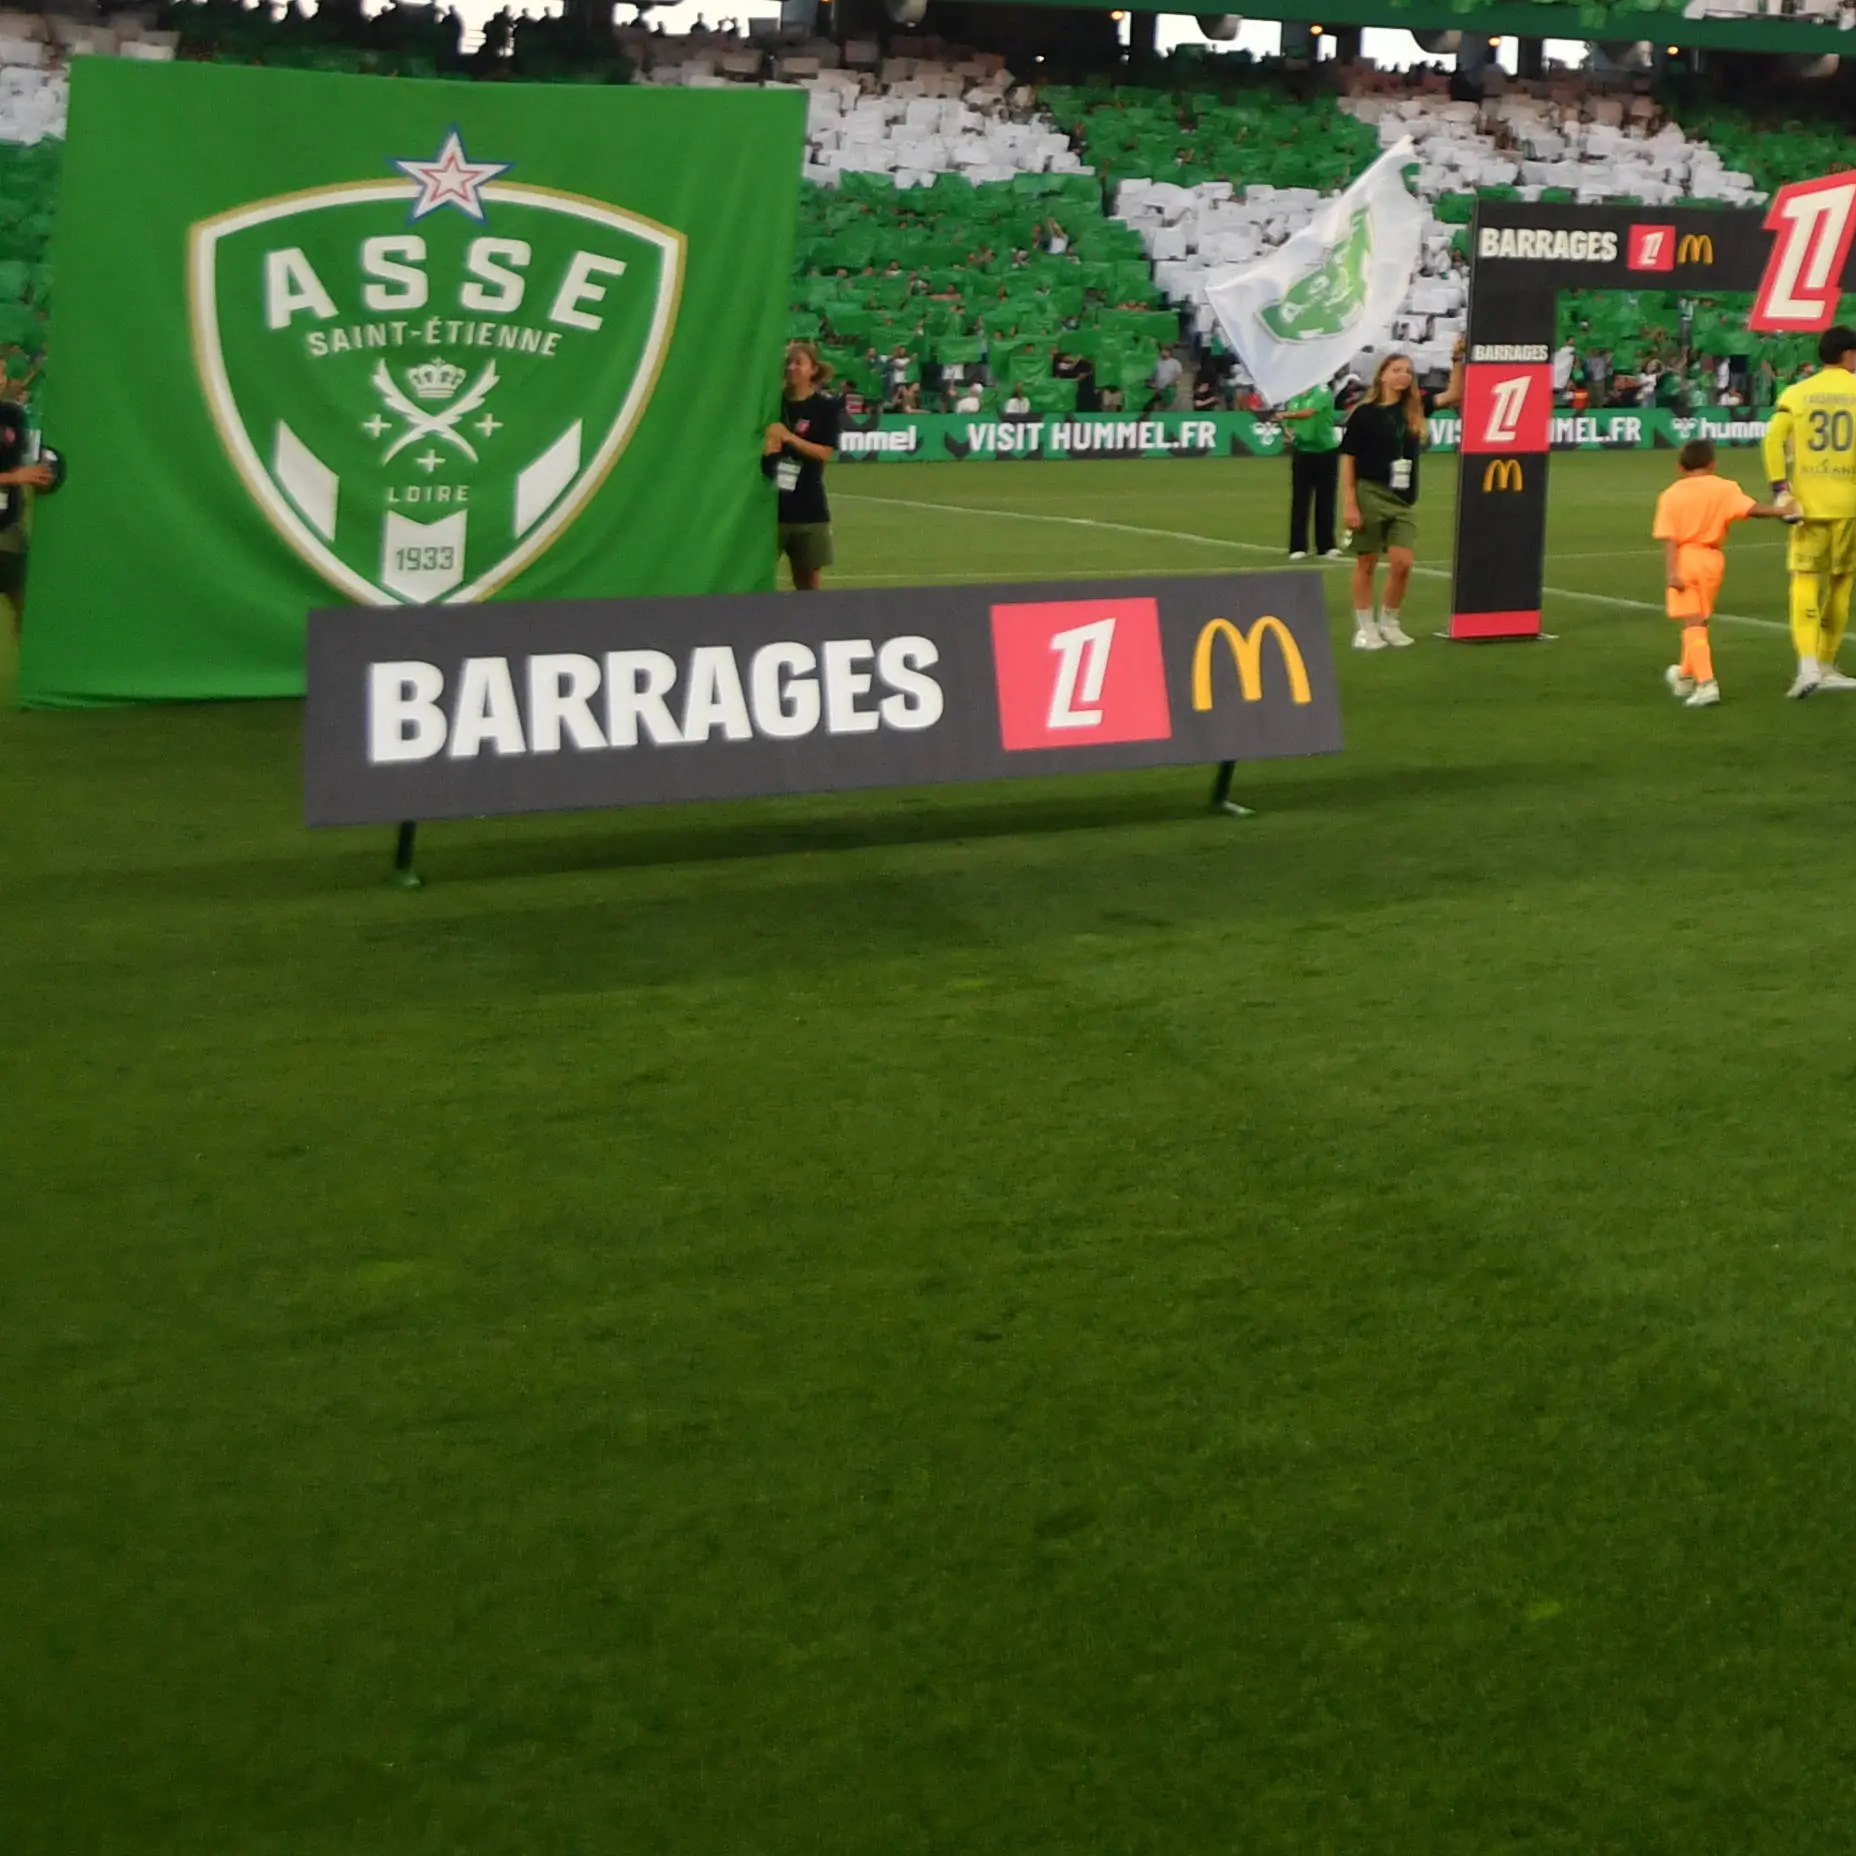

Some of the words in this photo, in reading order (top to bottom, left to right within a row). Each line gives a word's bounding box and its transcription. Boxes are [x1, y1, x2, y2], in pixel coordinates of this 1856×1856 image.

[1479, 227, 1618, 262] BARRAGES
[265, 234, 627, 331] ASSE
[307, 317, 562, 357] SAINT-ÉTIENNE
[1473, 344, 1548, 362] BARRAGES
[840, 425, 916, 452] mmel
[967, 422, 1045, 451] VISIT
[1050, 420, 1216, 451] HUMMEL.FR
[1807, 409, 1855, 452] 30
[388, 485, 469, 504] LOIRE
[395, 546, 455, 571] 1933
[366, 634, 945, 766] BARRAGES
